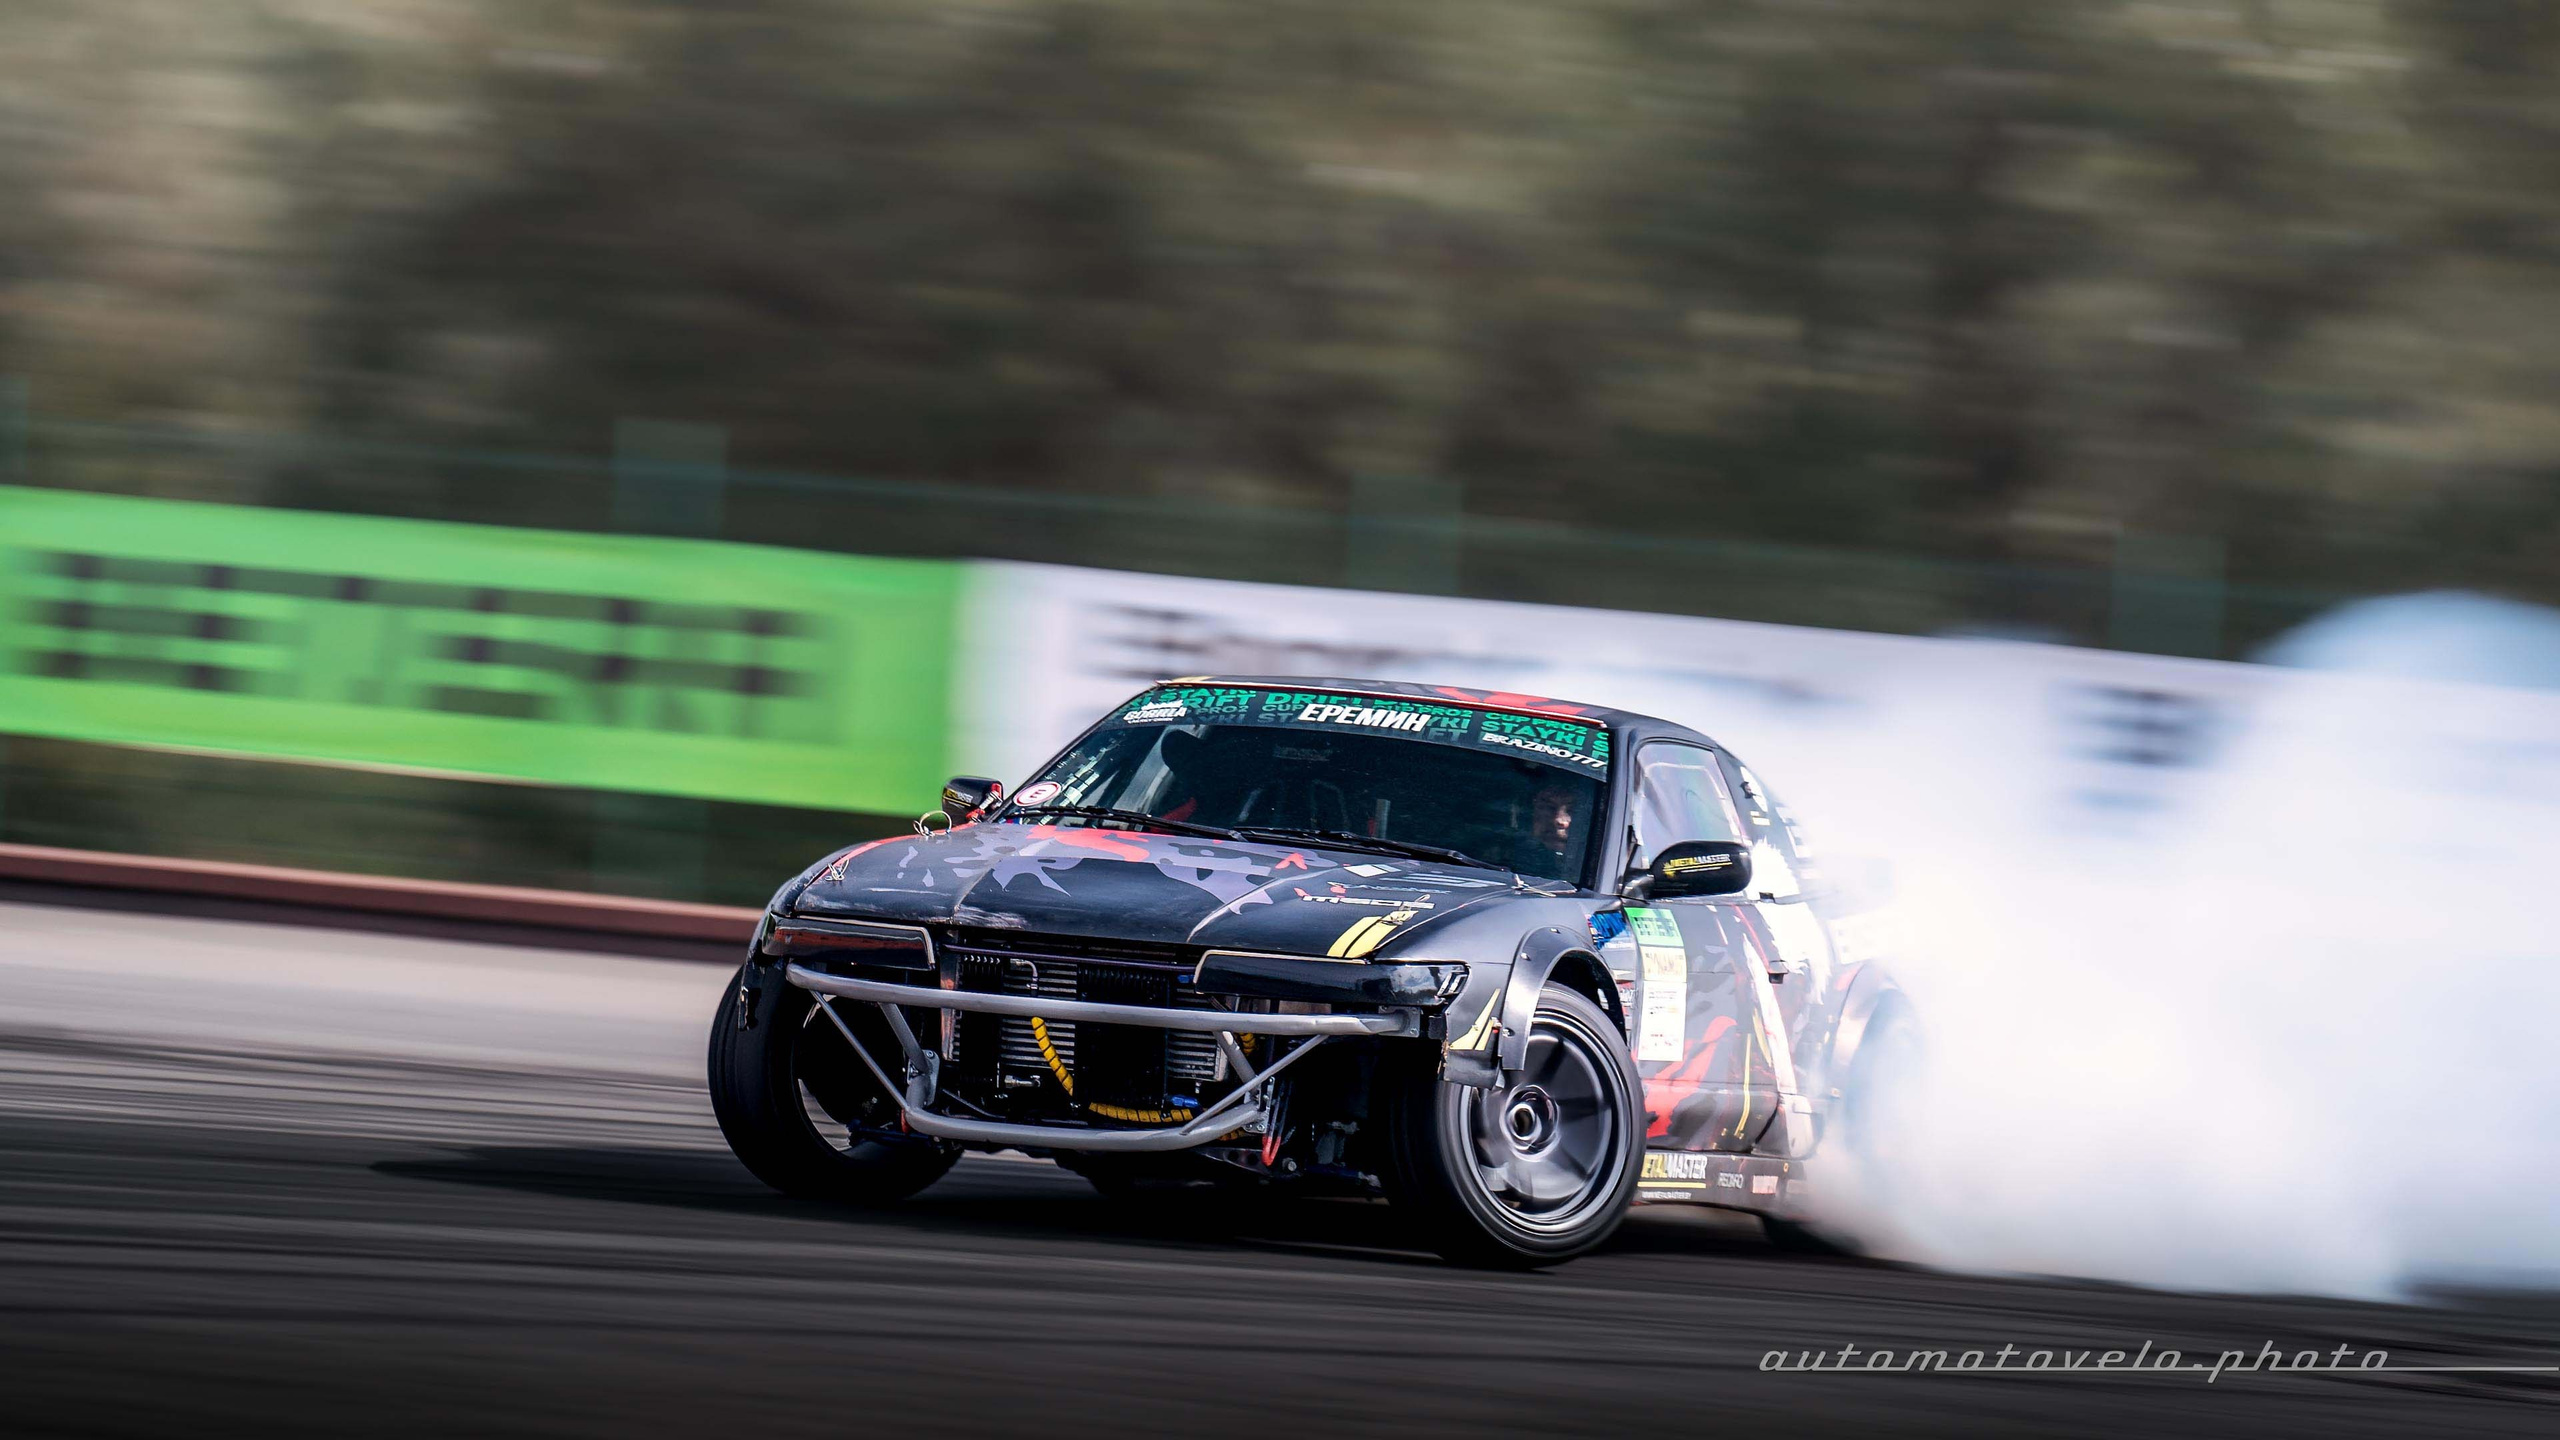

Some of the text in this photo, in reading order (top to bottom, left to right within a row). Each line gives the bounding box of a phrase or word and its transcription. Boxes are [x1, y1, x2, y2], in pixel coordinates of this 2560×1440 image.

[1123, 707, 1187, 720] GORILLA
[1298, 703, 1432, 732] ЕРЕМИН
[1485, 712, 1589, 735] CUP PRO2
[1480, 720, 1586, 746] STAYKI
